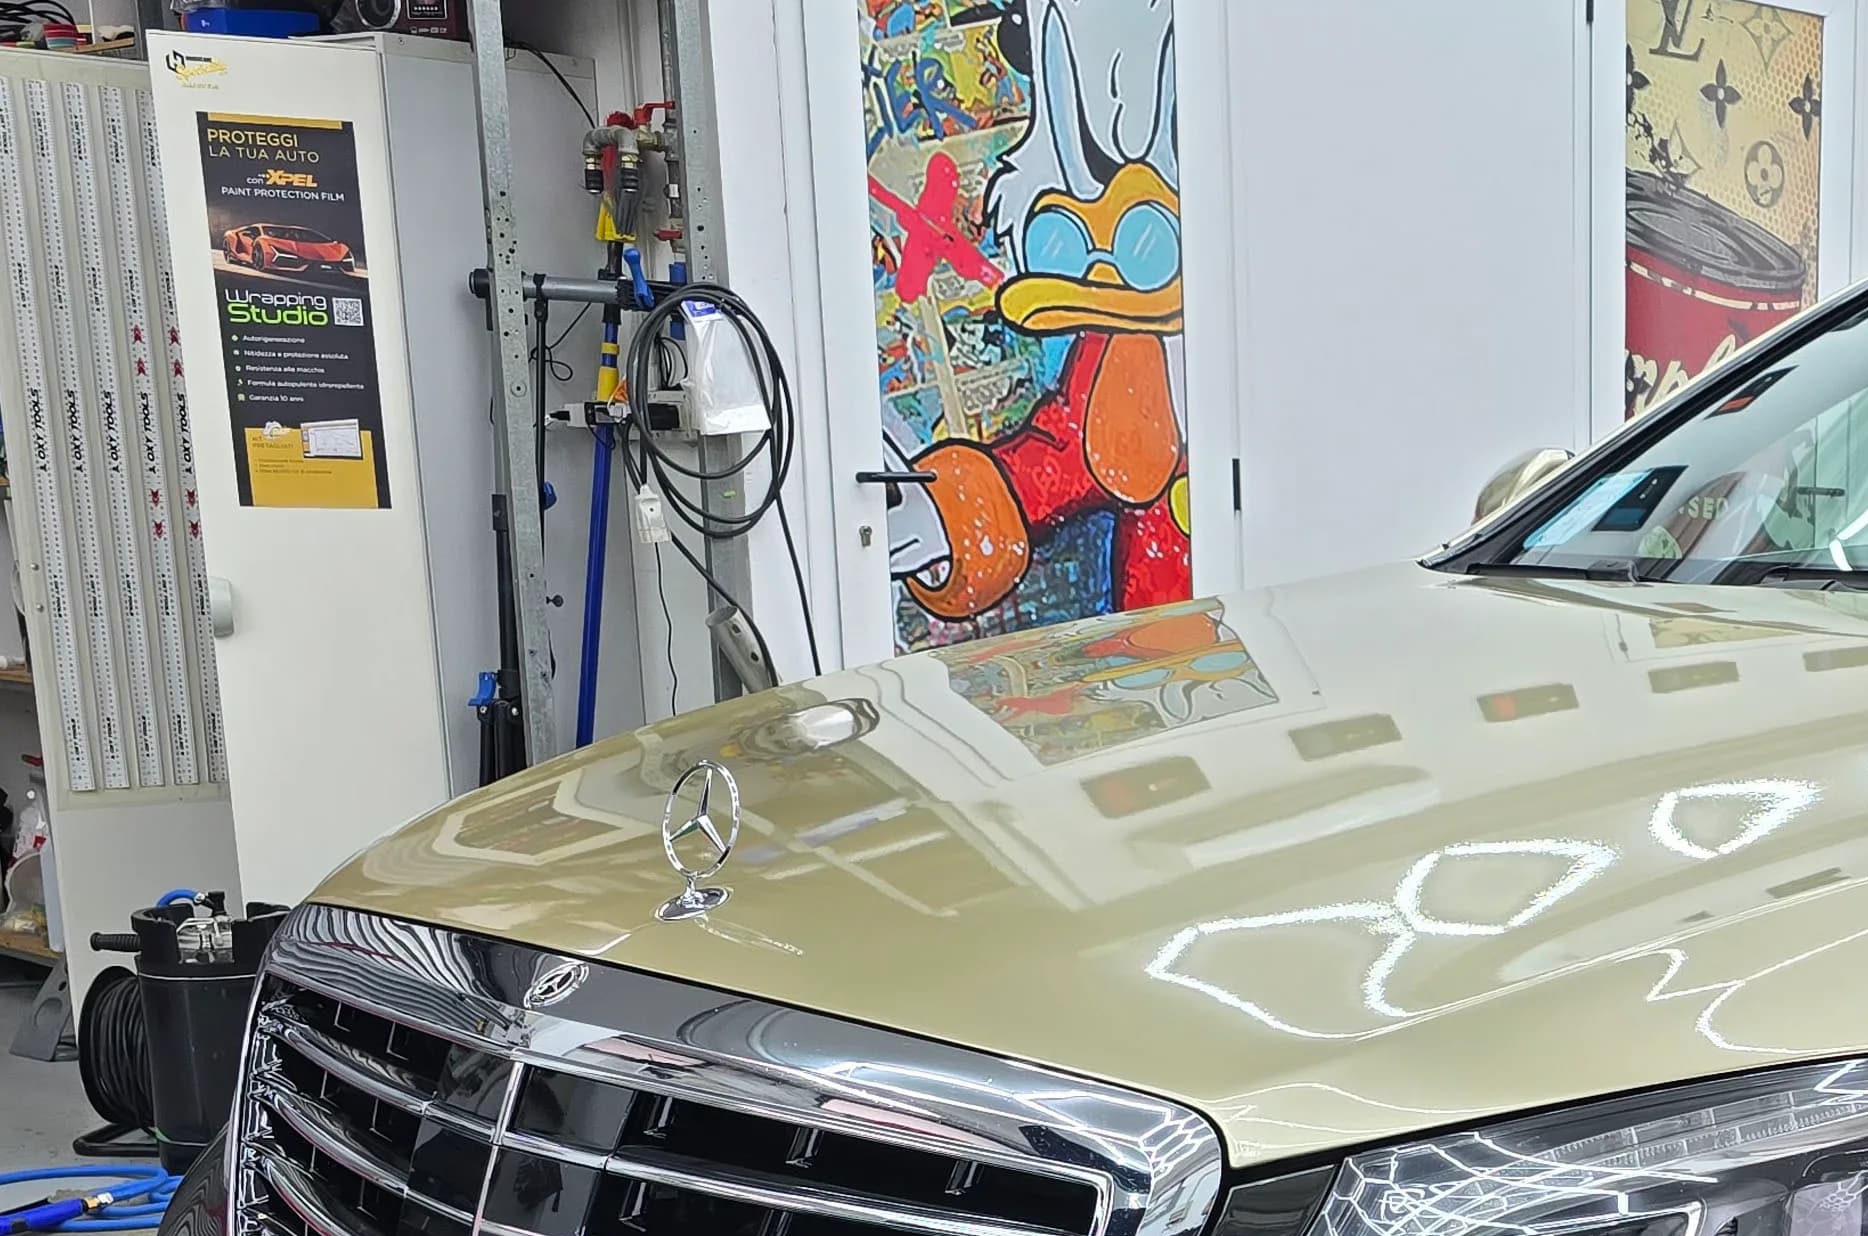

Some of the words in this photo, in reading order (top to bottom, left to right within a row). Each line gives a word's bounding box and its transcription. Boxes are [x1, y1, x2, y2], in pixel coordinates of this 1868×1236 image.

[207, 128, 298, 148] PROTEGGI
[208, 145, 230, 158] LA
[236, 147, 269, 161] TUA
[275, 149, 319, 164] AUTO
[246, 176, 264, 185] con
[265, 168, 318, 188] XPEL
[221, 186, 252, 198] PAINT
[254, 188, 319, 200] PROTECTION
[320, 192, 345, 202] FILM
[224, 288, 328, 311] Wrapping
[227, 303, 329, 326] Studio
[30, 388, 43, 430] TOOLS
[67, 389, 80, 431] TOOLS
[103, 390, 117, 431] TOOLS
[139, 391, 152, 432] TOOLS
[177, 392, 189, 432] TOOLS
[34, 433, 46, 459] OXY
[71, 435, 82, 460] OXY
[107, 435, 118, 461] OXY
[144, 436, 155, 462] OXY
[182, 437, 192, 462] OXY
